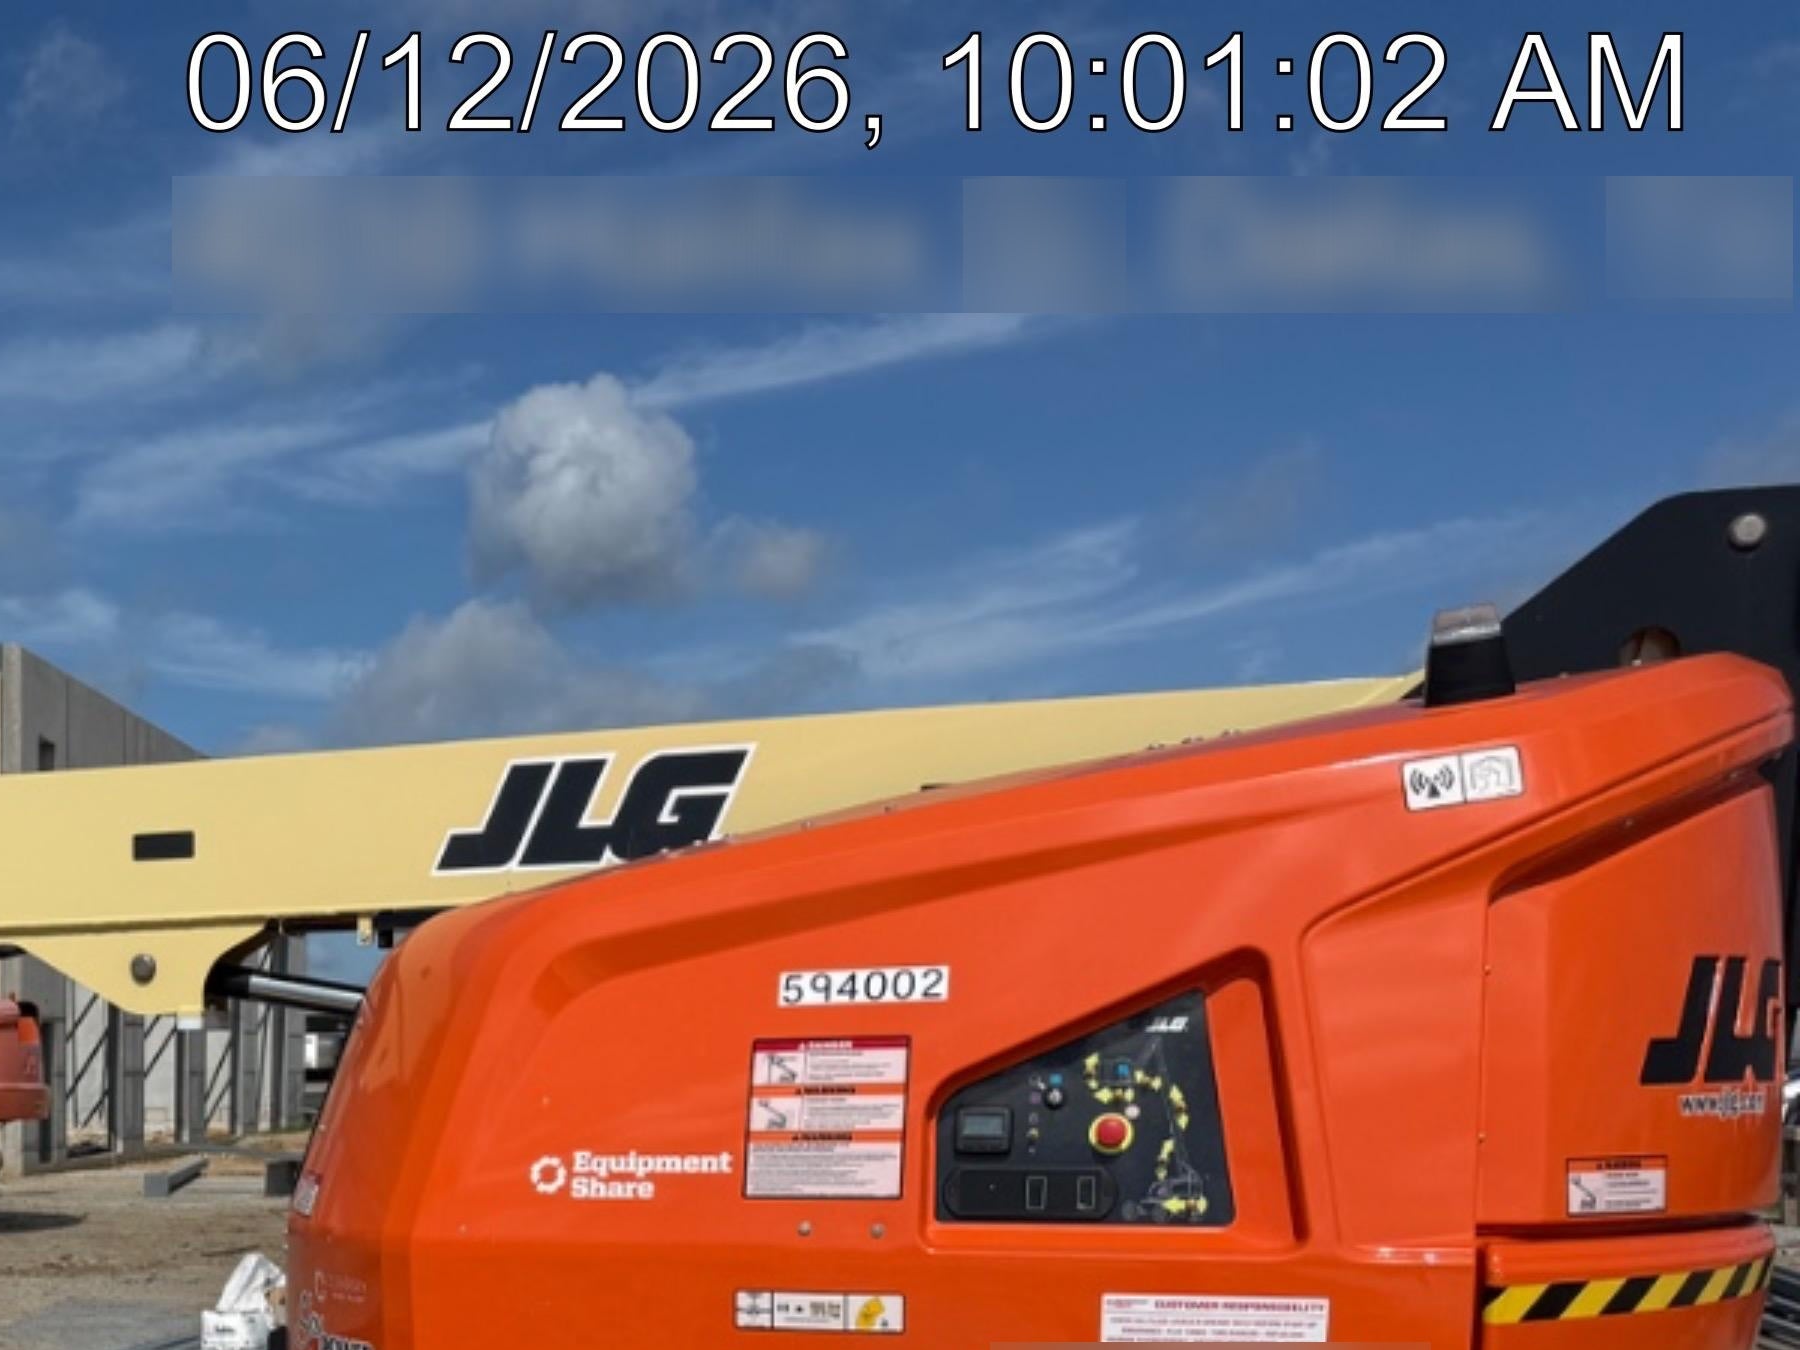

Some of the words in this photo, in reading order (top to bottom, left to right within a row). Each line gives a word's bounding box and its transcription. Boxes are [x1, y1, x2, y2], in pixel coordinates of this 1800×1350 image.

[433, 744, 756, 874] JLG
[781, 967, 946, 1004] 594002
[571, 1151, 733, 1179] Equipment
[571, 1176, 656, 1200] Share
